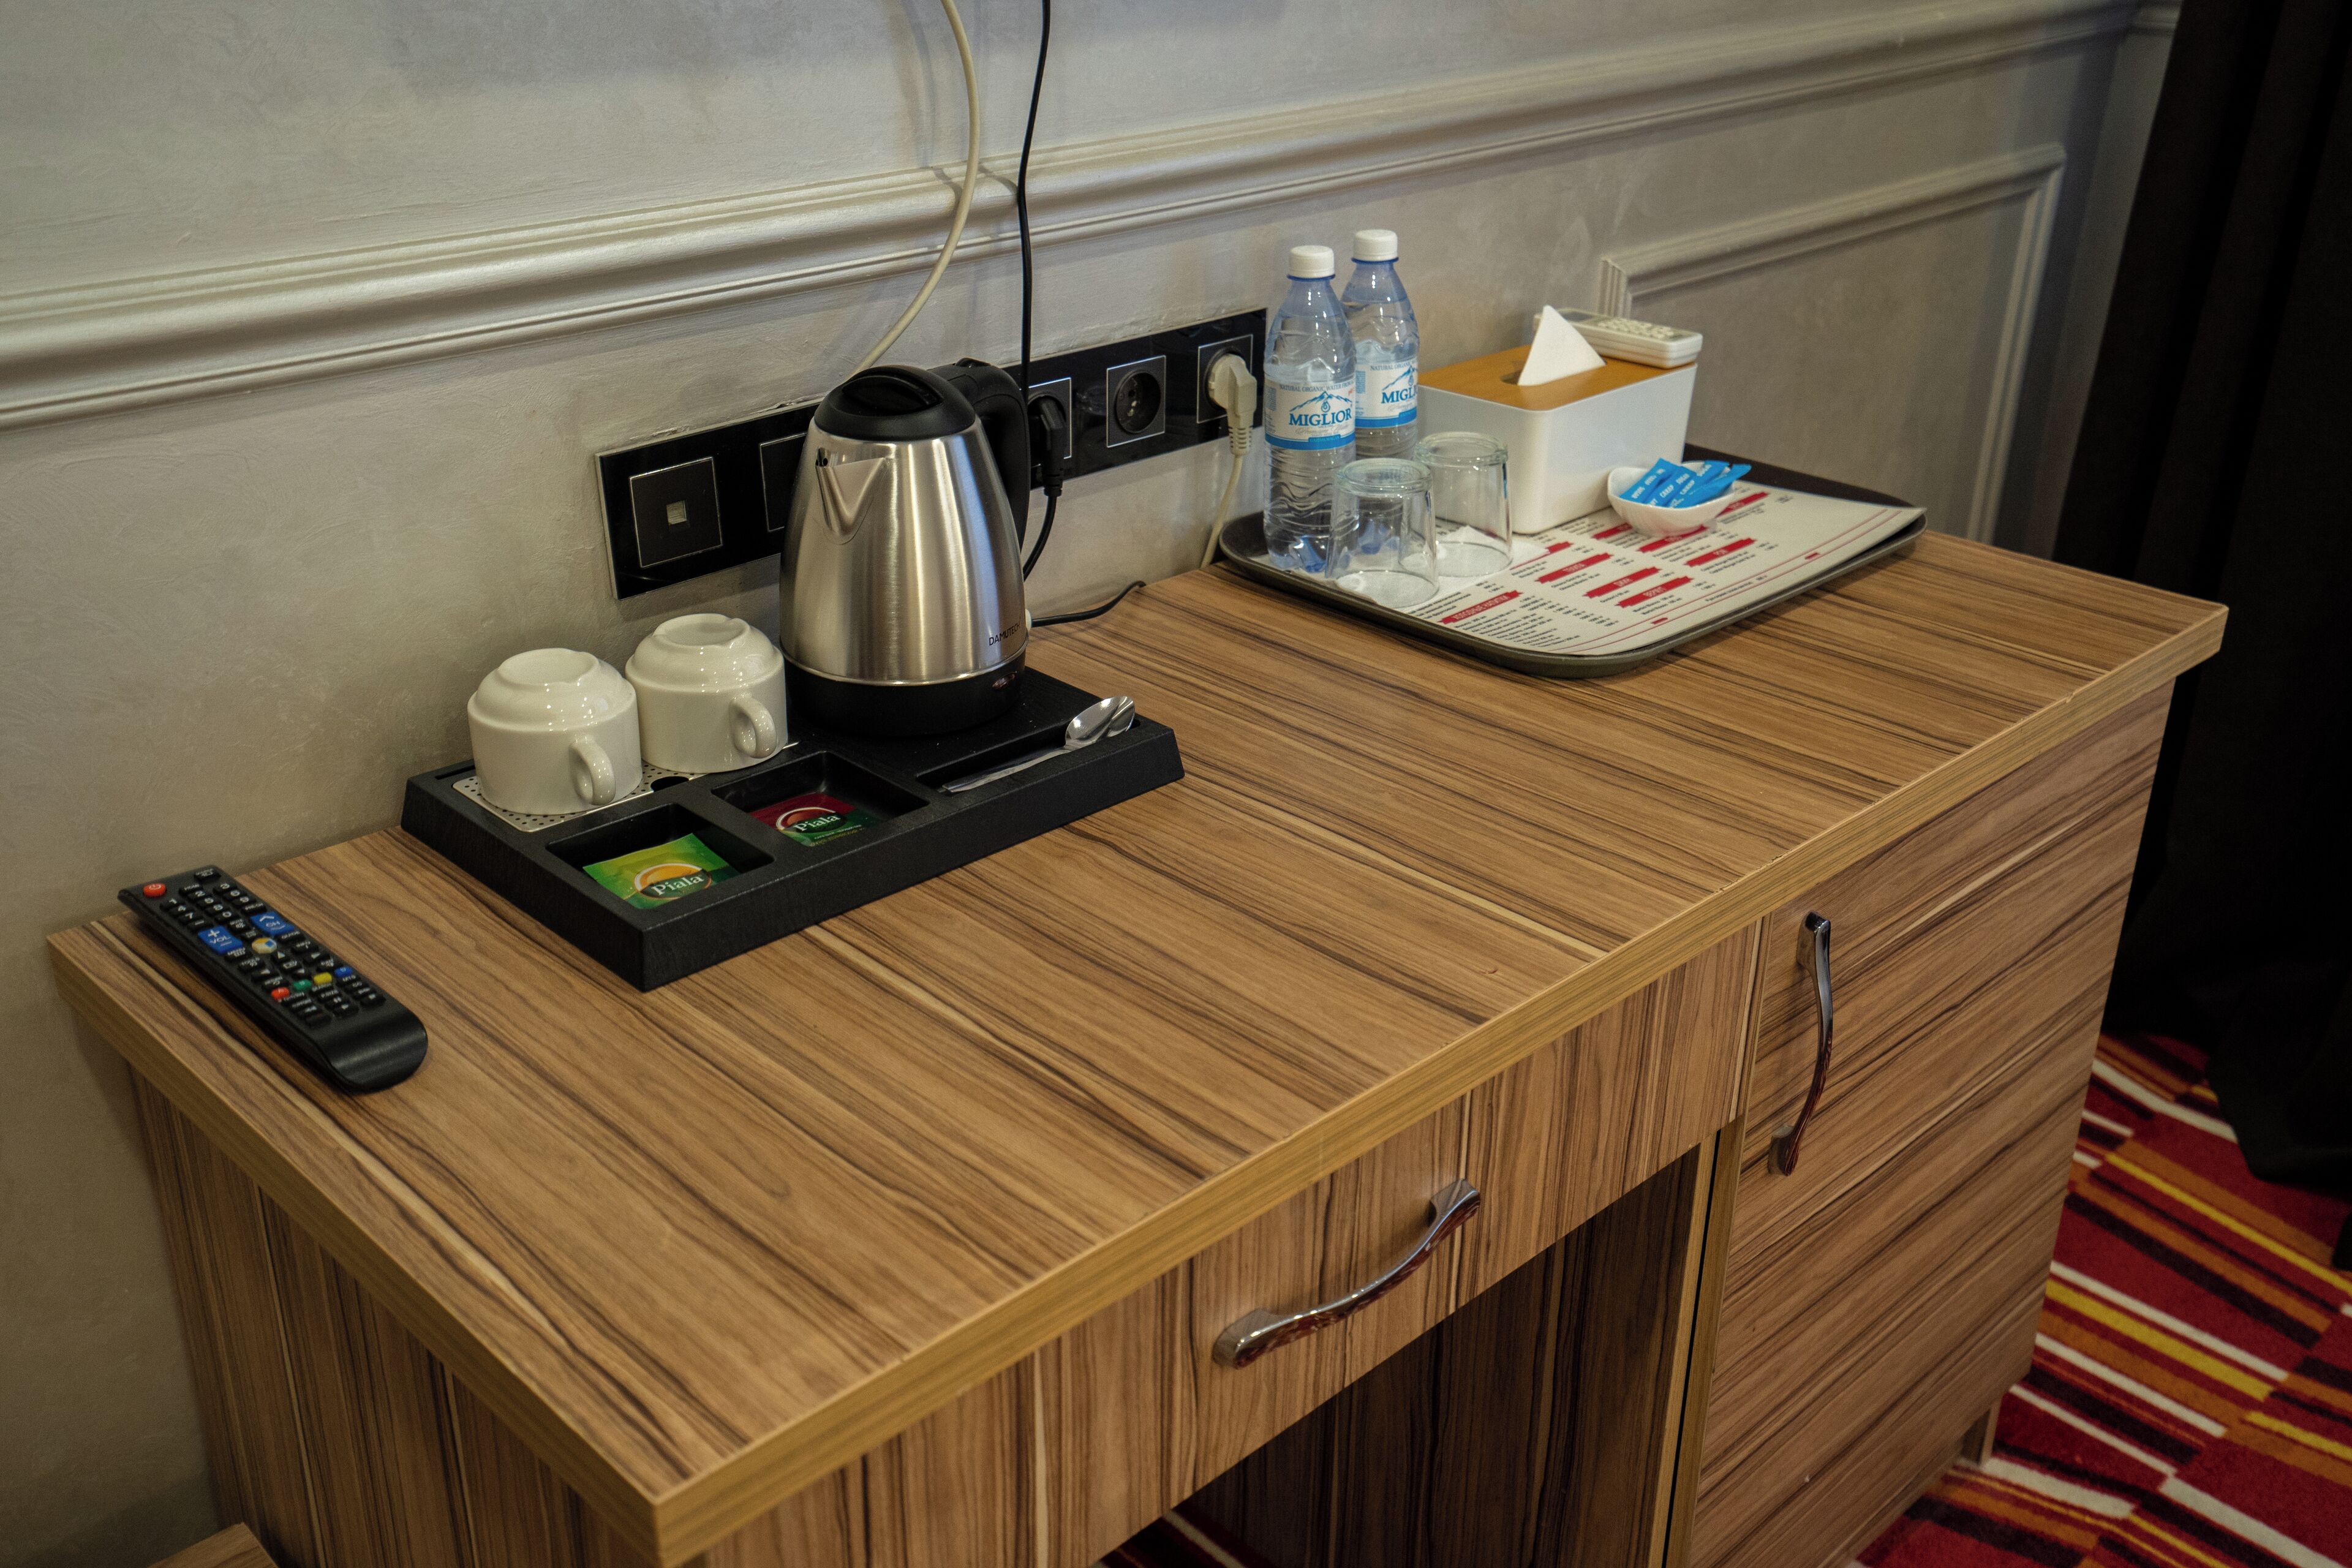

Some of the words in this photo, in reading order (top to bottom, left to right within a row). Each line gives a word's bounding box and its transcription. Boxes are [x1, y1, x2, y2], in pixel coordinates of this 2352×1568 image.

[1280, 383, 1301, 392] NATURAL
[1289, 408, 1352, 426] MIGLIOR
[793, 815, 841, 832] Piala
[651, 876, 705, 896] Piala
[209, 935, 231, 944] VOL
